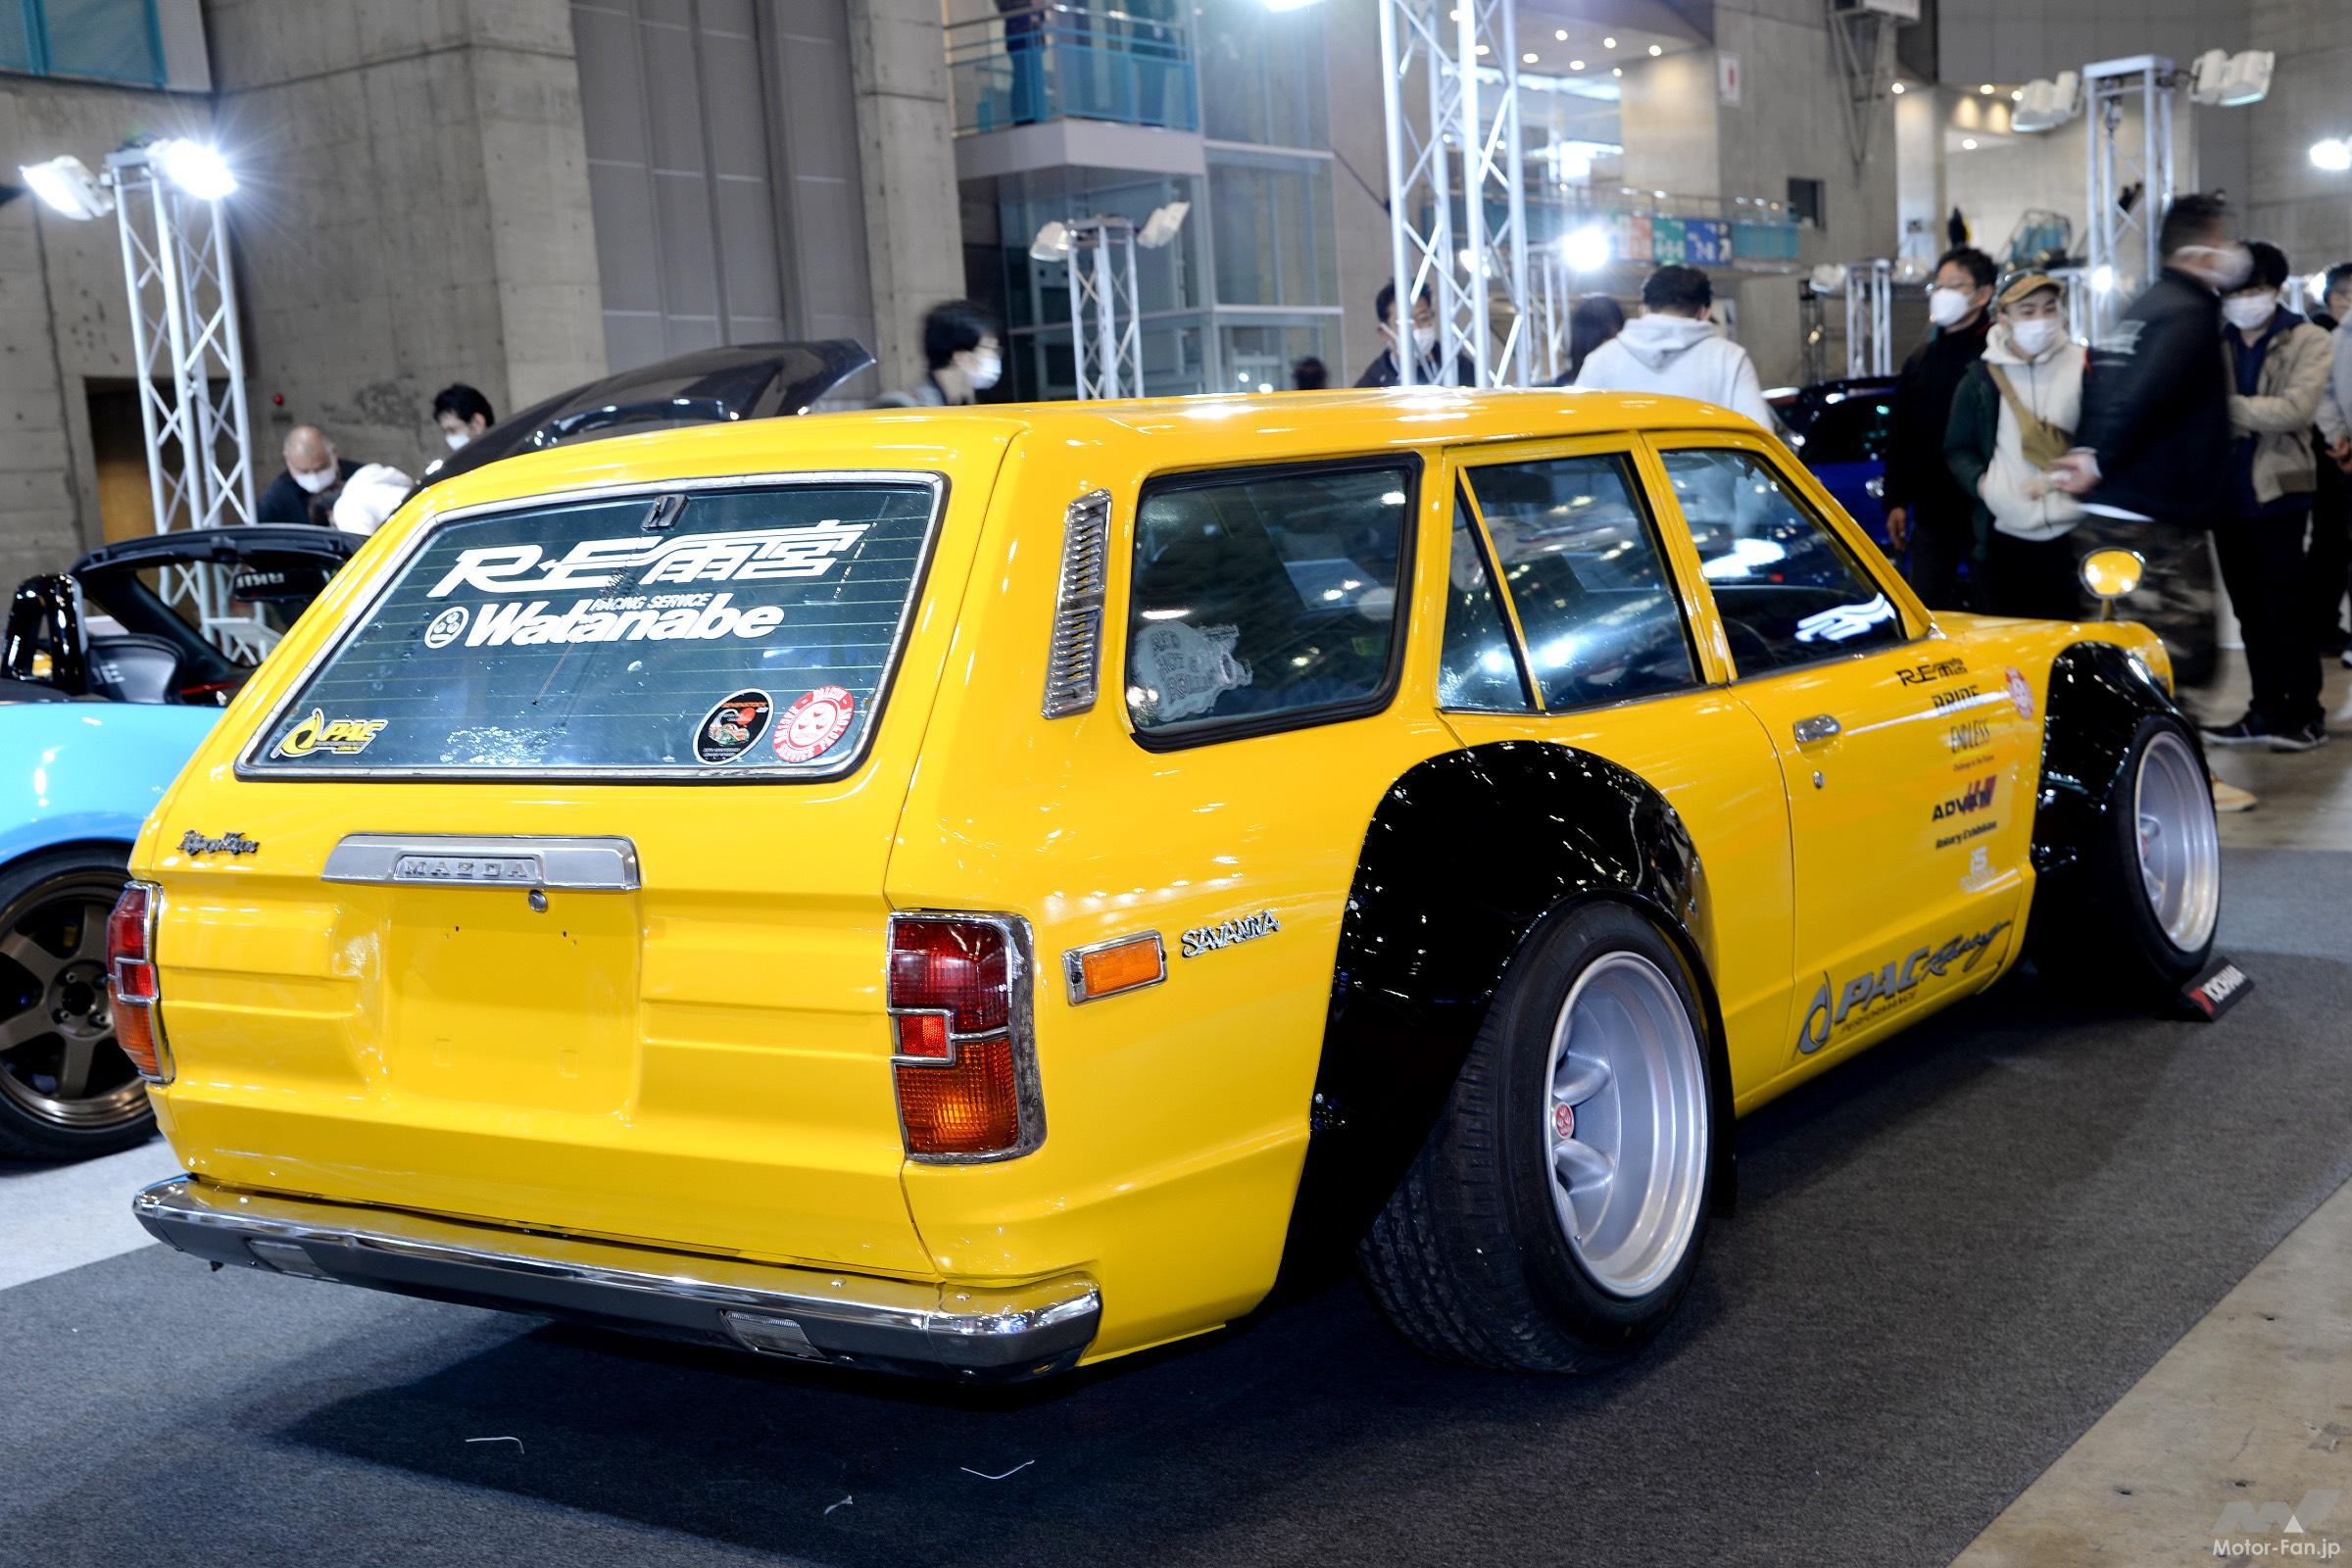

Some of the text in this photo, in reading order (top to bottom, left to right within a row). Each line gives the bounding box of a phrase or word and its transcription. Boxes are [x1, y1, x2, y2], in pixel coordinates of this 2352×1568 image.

[465, 592, 784, 647] Watanabe
[590, 592, 712, 612] RACING SERVICE
[404, 860, 530, 878] MAZDA
[1181, 908, 1282, 957] SAVANNA
[1835, 945, 1930, 1026] PAC
